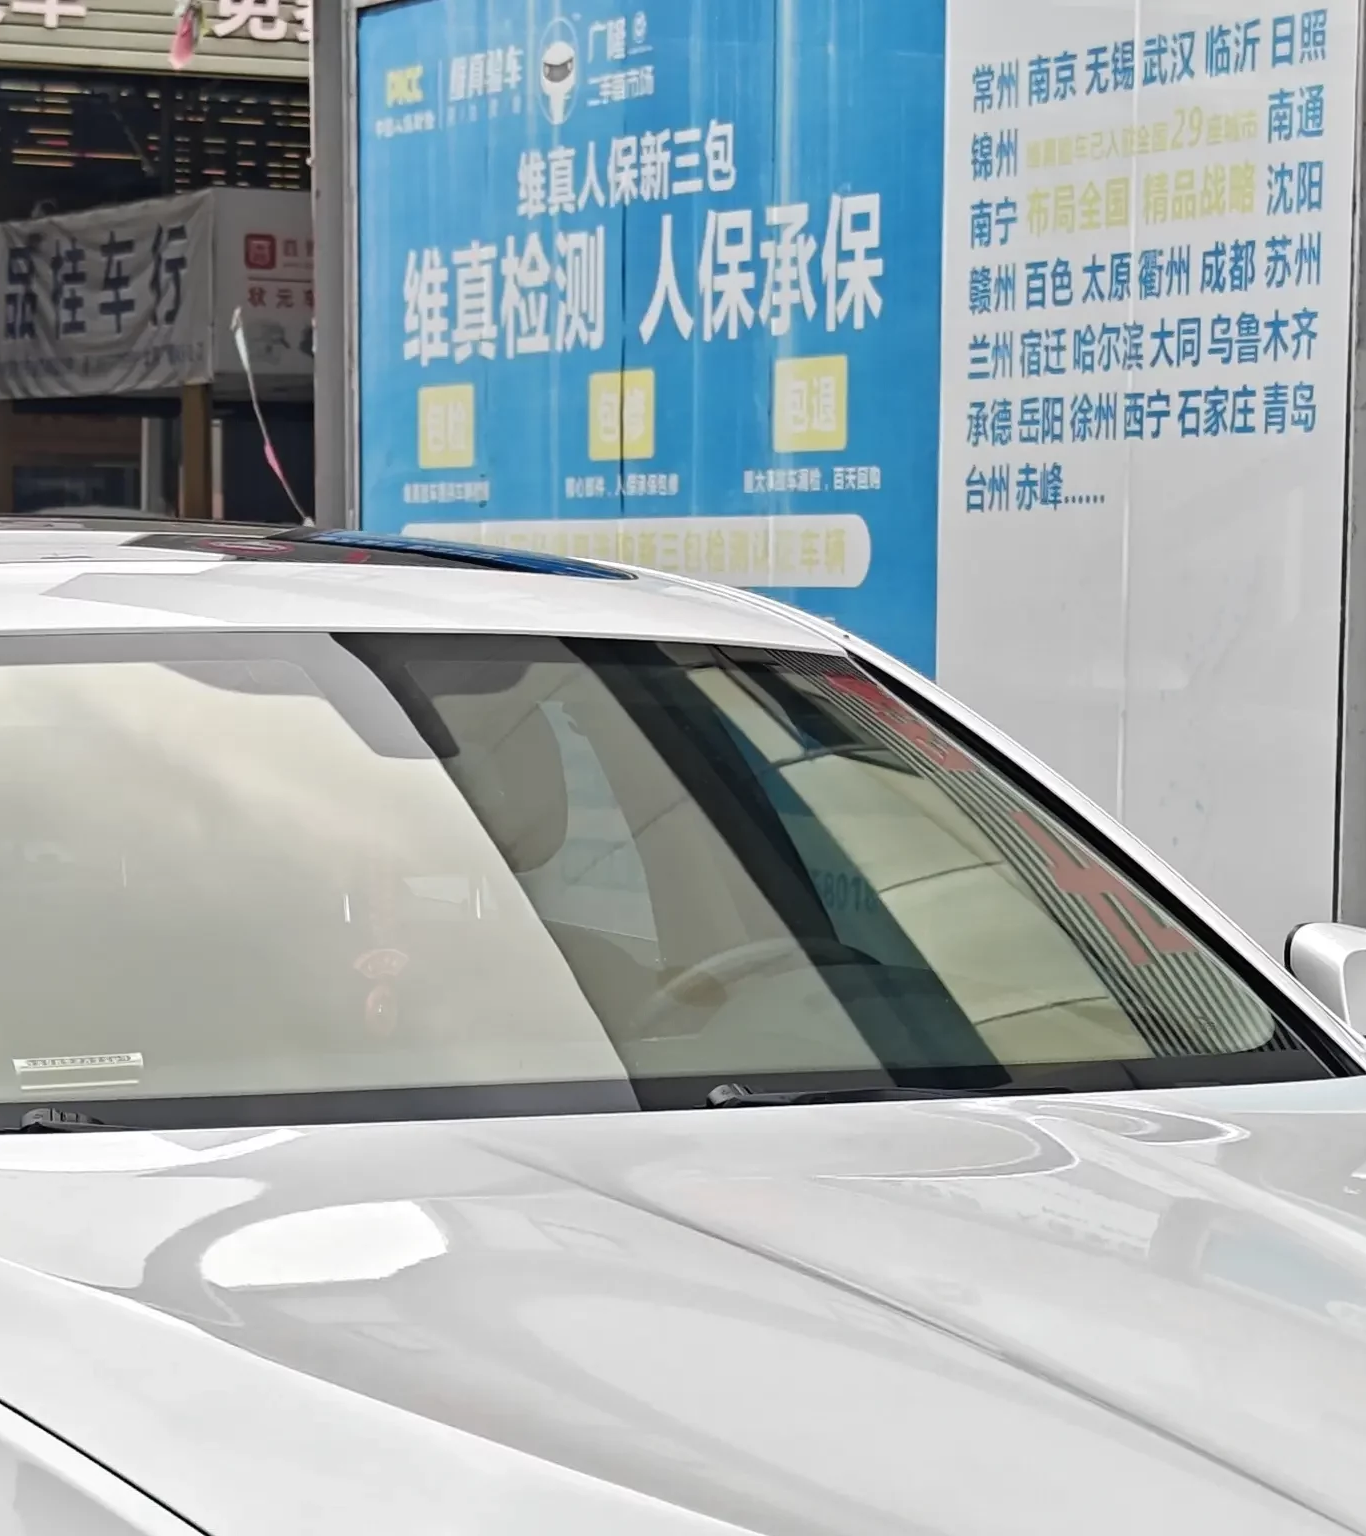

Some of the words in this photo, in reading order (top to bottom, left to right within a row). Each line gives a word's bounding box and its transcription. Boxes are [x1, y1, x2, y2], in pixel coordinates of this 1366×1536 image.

[972, 59, 1020, 113] 常州
[1027, 51, 1077, 107] 南京
[1085, 39, 1136, 96] 无锡
[1142, 30, 1196, 87] 武汉
[1205, 19, 1261, 78] 临沂
[1271, 8, 1328, 68] 日照
[516, 118, 737, 221] 维真人保新三包
[970, 128, 1019, 182] 锦州
[1267, 83, 1325, 145] 南通
[970, 196, 1018, 250] 南宁
[1026, 176, 1130, 238] 布局全国
[1142, 159, 1257, 226] 精品战略
[1266, 160, 1323, 217] 沈阳
[402, 224, 606, 367] 维真检测
[638, 192, 884, 345] 人保承保
[968, 263, 1016, 315] 赣州
[1025, 257, 1074, 311] 百色
[1082, 252, 1132, 304] 太原
[1138, 245, 1191, 300] 衢州
[1200, 238, 1256, 295] 成都
[1265, 231, 1322, 289] 苏州
[968, 331, 1014, 380] 兰州
[1020, 327, 1067, 378] 宿迁
[1072, 320, 1145, 374] 哈尔滨
[1150, 317, 1201, 369] 大同
[1207, 307, 1319, 365] 乌鲁木齐
[967, 398, 1013, 448] 承德
[1018, 396, 1064, 446] 岳阳
[1070, 391, 1118, 443] 徐州
[1123, 388, 1171, 441] 西宁
[1177, 384, 1257, 438] 石家庄
[1263, 381, 1317, 435] 青岛
[965, 463, 1010, 513] 台州
